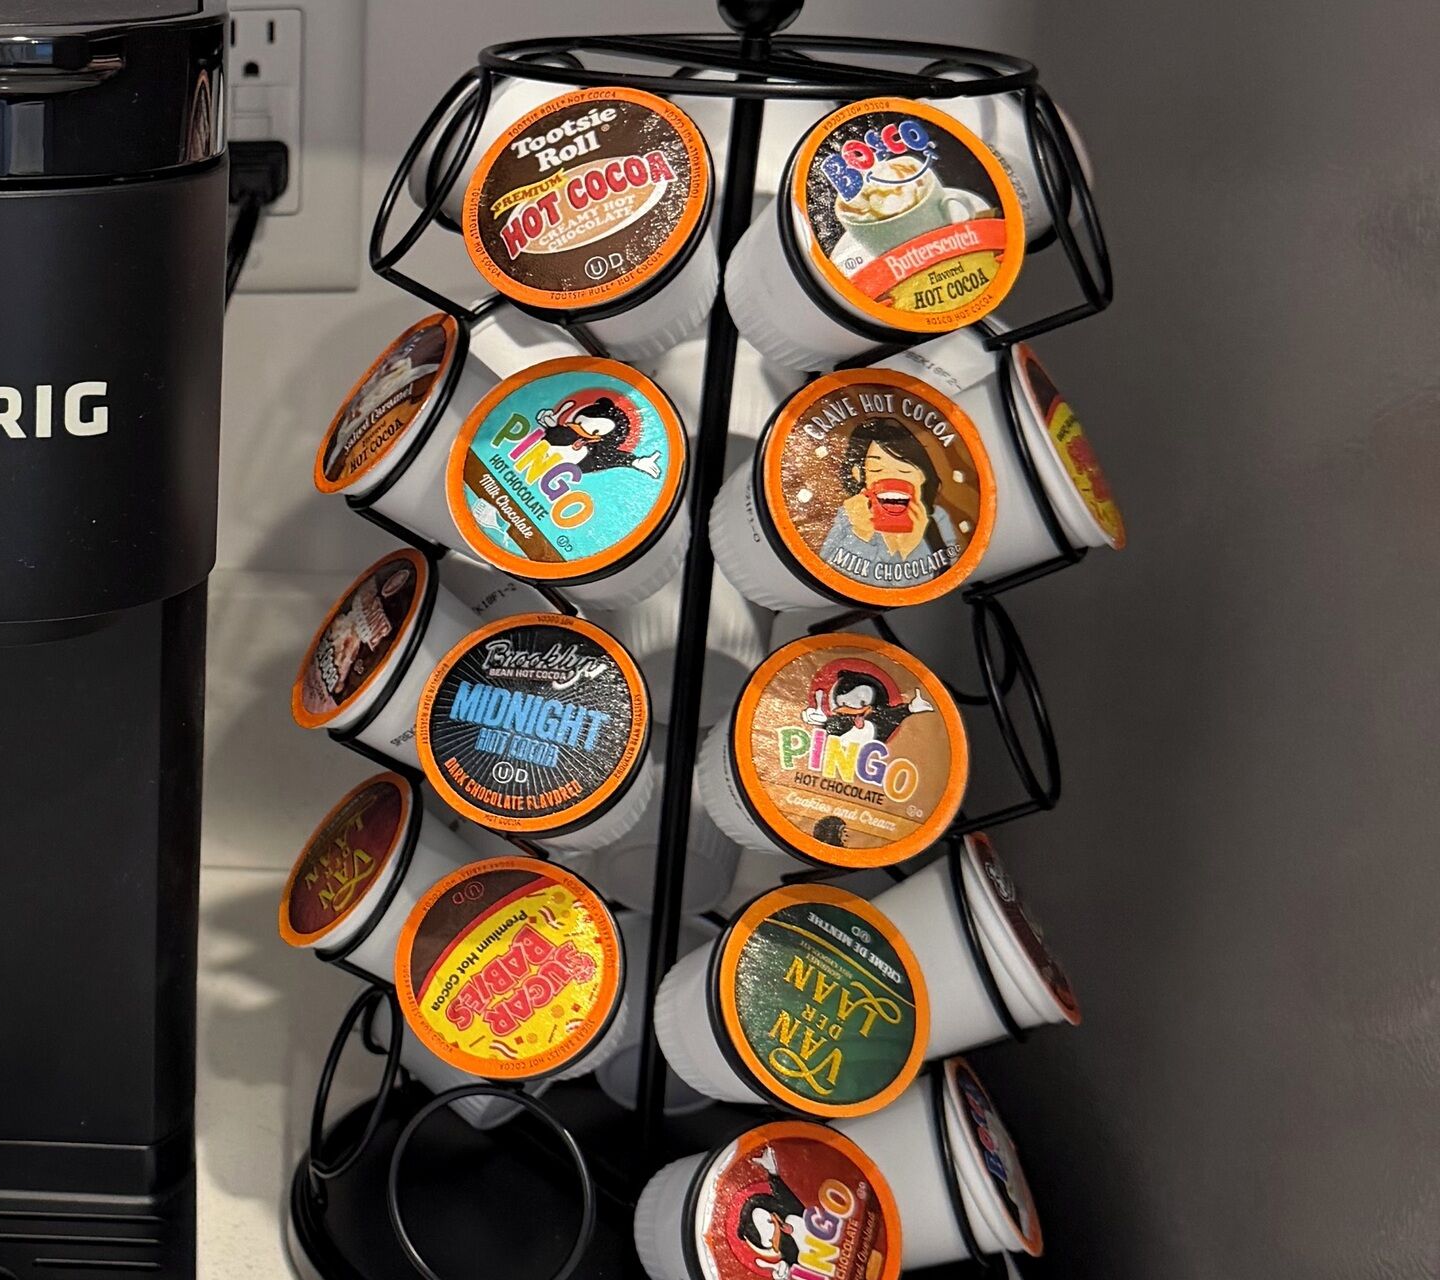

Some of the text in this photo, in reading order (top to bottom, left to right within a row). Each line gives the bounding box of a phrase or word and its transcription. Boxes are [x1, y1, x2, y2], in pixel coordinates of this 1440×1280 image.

[511, 107, 618, 159] Tootsie
[535, 131, 601, 172] Roll
[821, 120, 932, 203] BOSCO
[494, 173, 563, 213] PREMIUM
[500, 150, 677, 260] HOT COCOA
[538, 194, 636, 247] CREAMY HOT
[548, 206, 634, 251] CHOCOLATE
[884, 223, 980, 281] Butterscotch
[927, 261, 965, 286] Flavored
[914, 268, 990, 310] HOT COCOA
[349, 418, 404, 474] HOT COCOA
[803, 393, 958, 448] CRAVE HOT COCOA
[489, 412, 594, 530] PINGO
[489, 454, 548, 522] HOT CHOCOLATE
[478, 473, 534, 540] Milk Chocolate
[833, 547, 948, 581] MILK CHOCOLATE
[482, 639, 608, 690] Brooklyn
[489, 668, 568, 681] BEAN HOT COCOA
[449, 680, 611, 754] MIDNIGHT
[444, 757, 583, 811] DARK CHOCOLATE FLAVORED
[776, 725, 919, 803] PINGO
[794, 771, 885, 806] HOT CHOCOLATE
[833, 803, 858, 821] and
[807, 912, 854, 947] MENTHE
[852, 941, 869, 958] DE
[431, 909, 528, 1012] Premium Hot Cocoa
[445, 922, 558, 1031] BABIES
[483, 939, 598, 1037] SUGAR
[801, 1003, 844, 1041] DER
[768, 1008, 844, 1096] VAN
